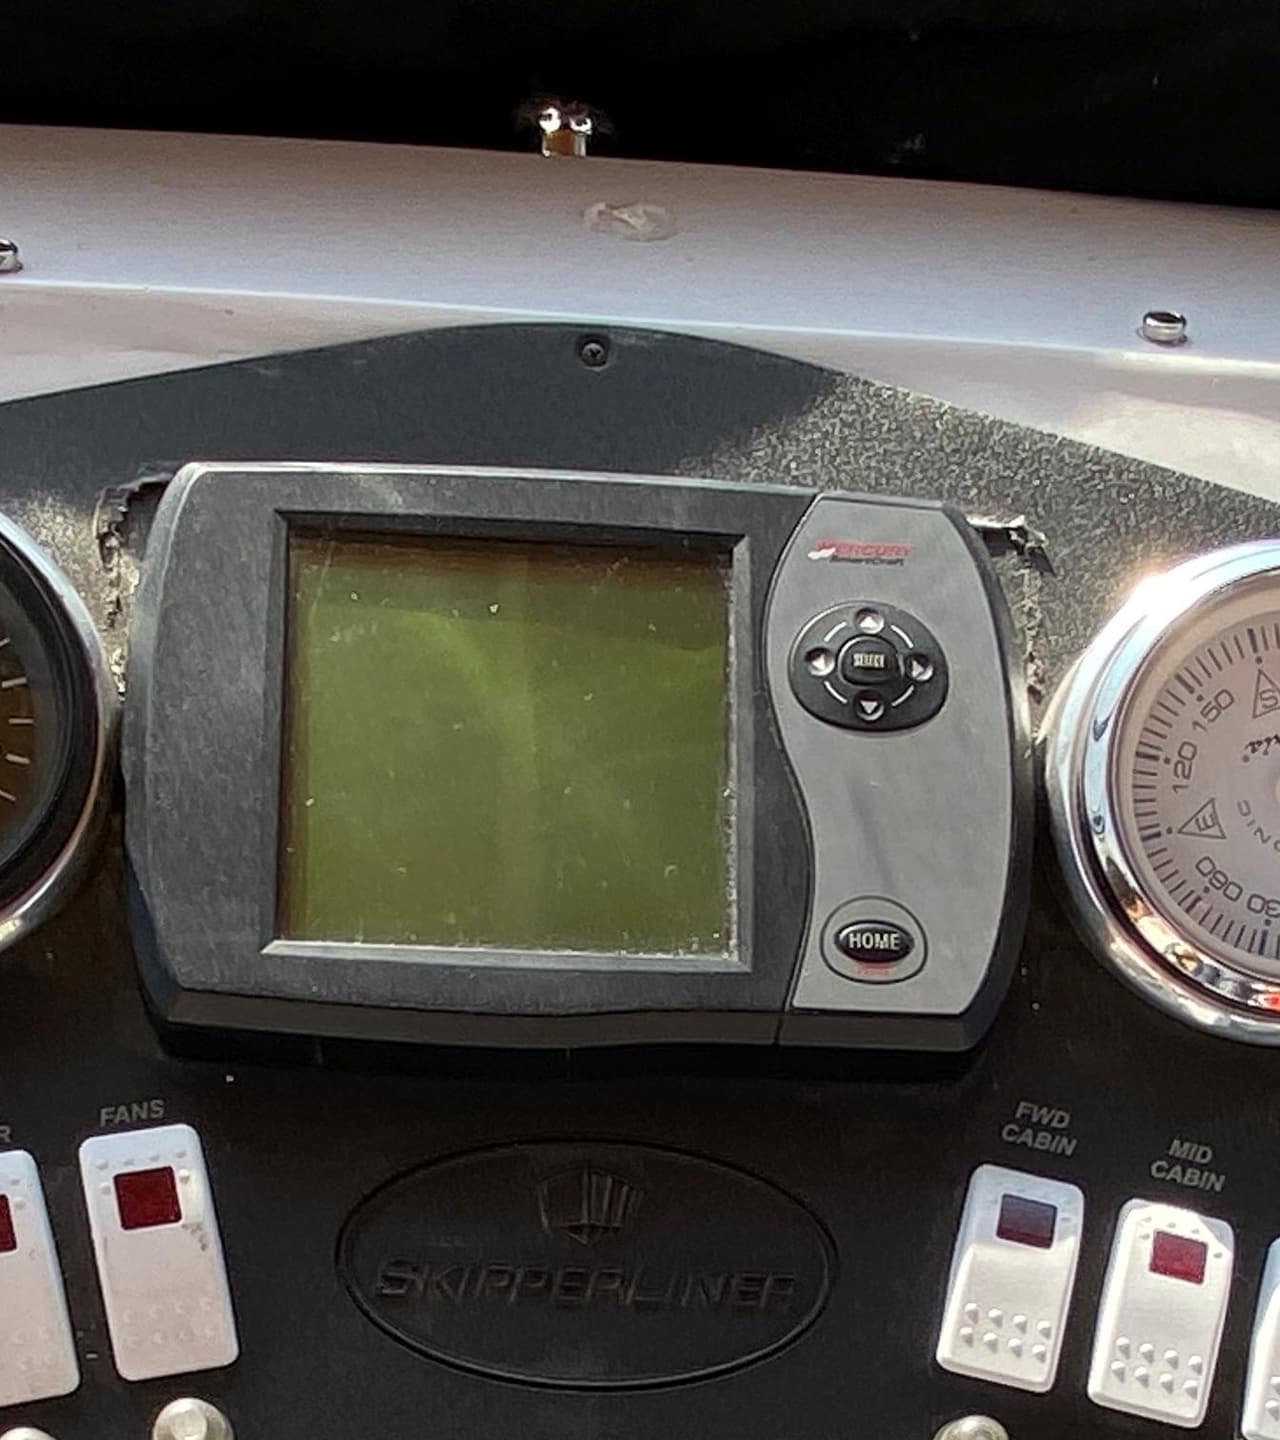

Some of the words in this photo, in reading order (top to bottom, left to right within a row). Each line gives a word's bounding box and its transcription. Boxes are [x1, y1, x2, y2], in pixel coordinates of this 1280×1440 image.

[1192, 689, 1235, 732] 150
[1259, 687, 1279, 709] S
[1172, 740, 1197, 795] 120
[1195, 856, 1244, 903] 060
[849, 931, 900, 952] HOME
[100, 1100, 165, 1127] FANS
[1015, 1101, 1071, 1129] FWD
[1001, 1124, 1077, 1156] CABIN
[1169, 1139, 1213, 1165] MID
[1151, 1160, 1225, 1192] CABIN
[375, 1259, 797, 1306] SKIPPERLINER
